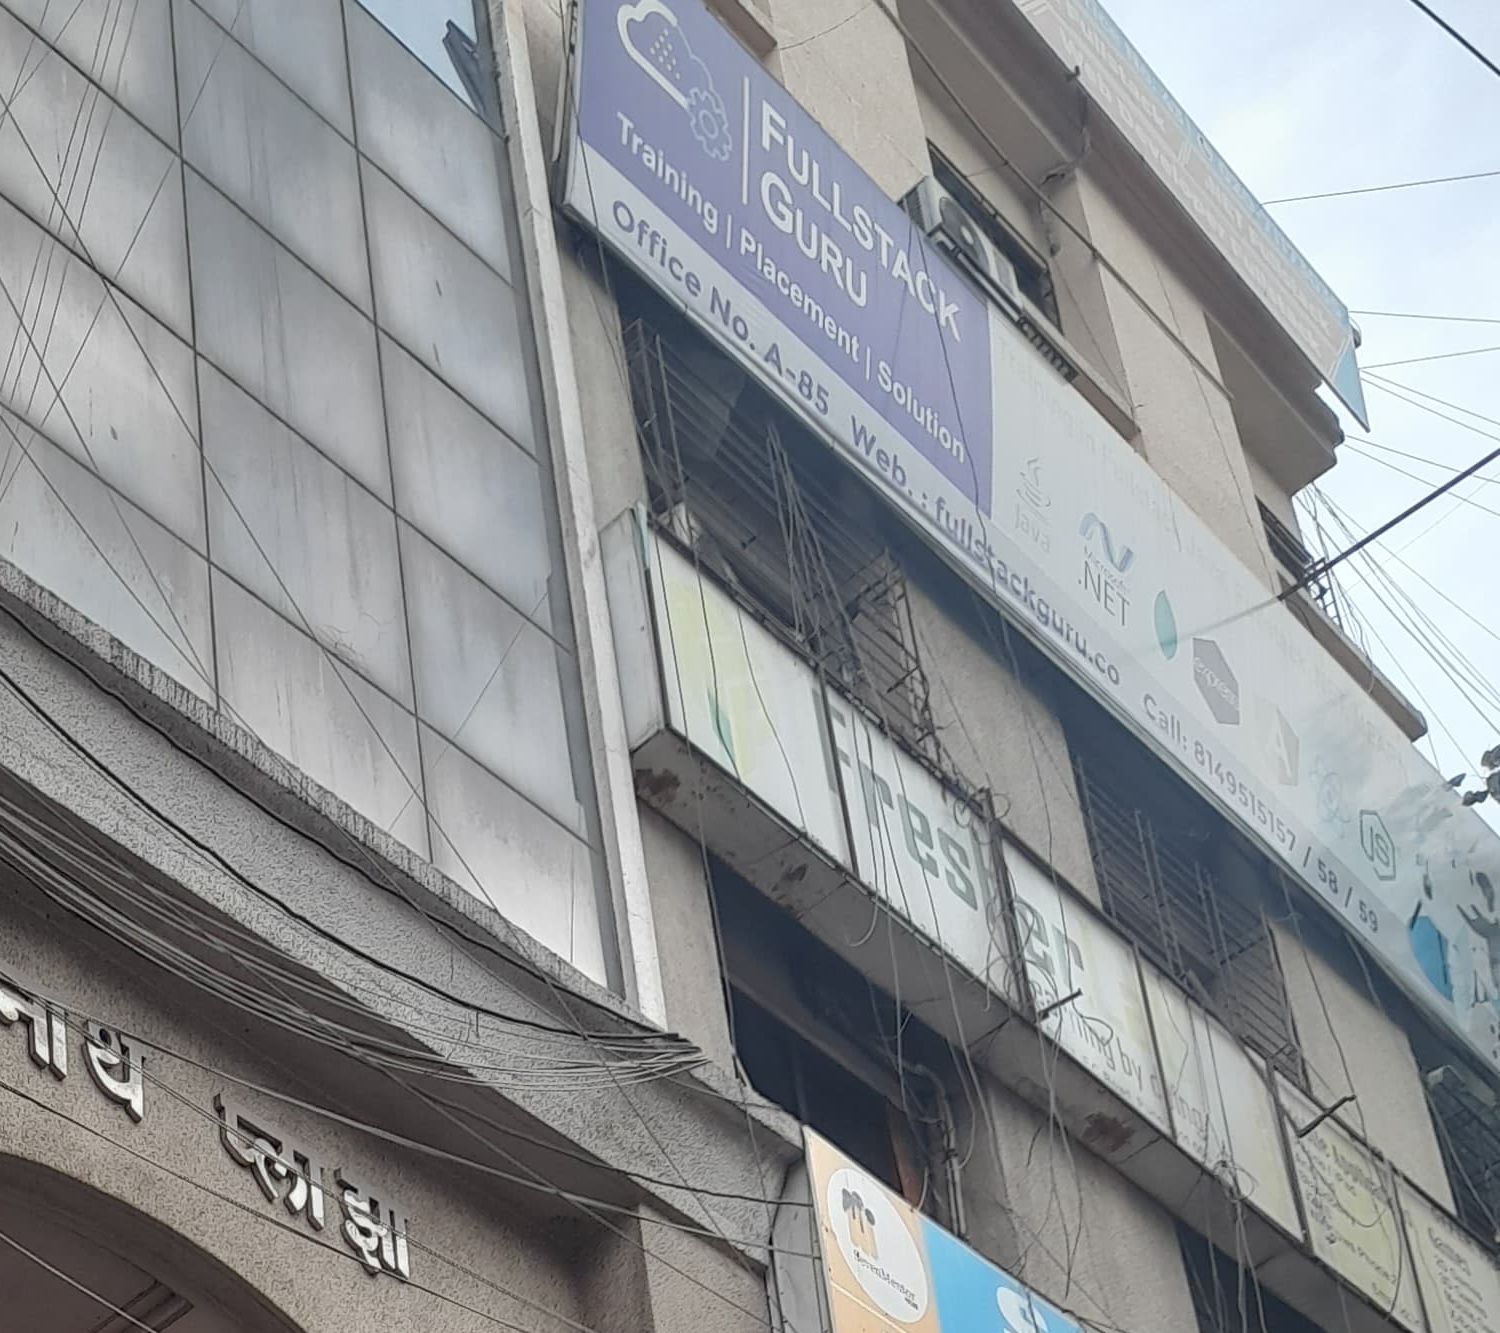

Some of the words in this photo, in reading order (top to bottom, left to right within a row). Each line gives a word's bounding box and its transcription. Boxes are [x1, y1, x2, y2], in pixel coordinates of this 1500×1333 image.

[616, 112, 719, 235] Training
[739, 228, 861, 364] Placement
[877, 360, 965, 463] Solution
[760, 99, 962, 343] FULLSTACK
[760, 170, 868, 308] GURU
[612, 200, 701, 298] Office
[709, 285, 757, 353] No.
[763, 342, 831, 415] A-85
[1143, 693, 1188, 752] Call:
[1194, 742, 1297, 851] 8149515157
[1317, 861, 1340, 895] 58
[1358, 901, 1379, 934] 59
[1078, 559, 1131, 627] .NET
[1116, 1034, 1143, 1092] by
